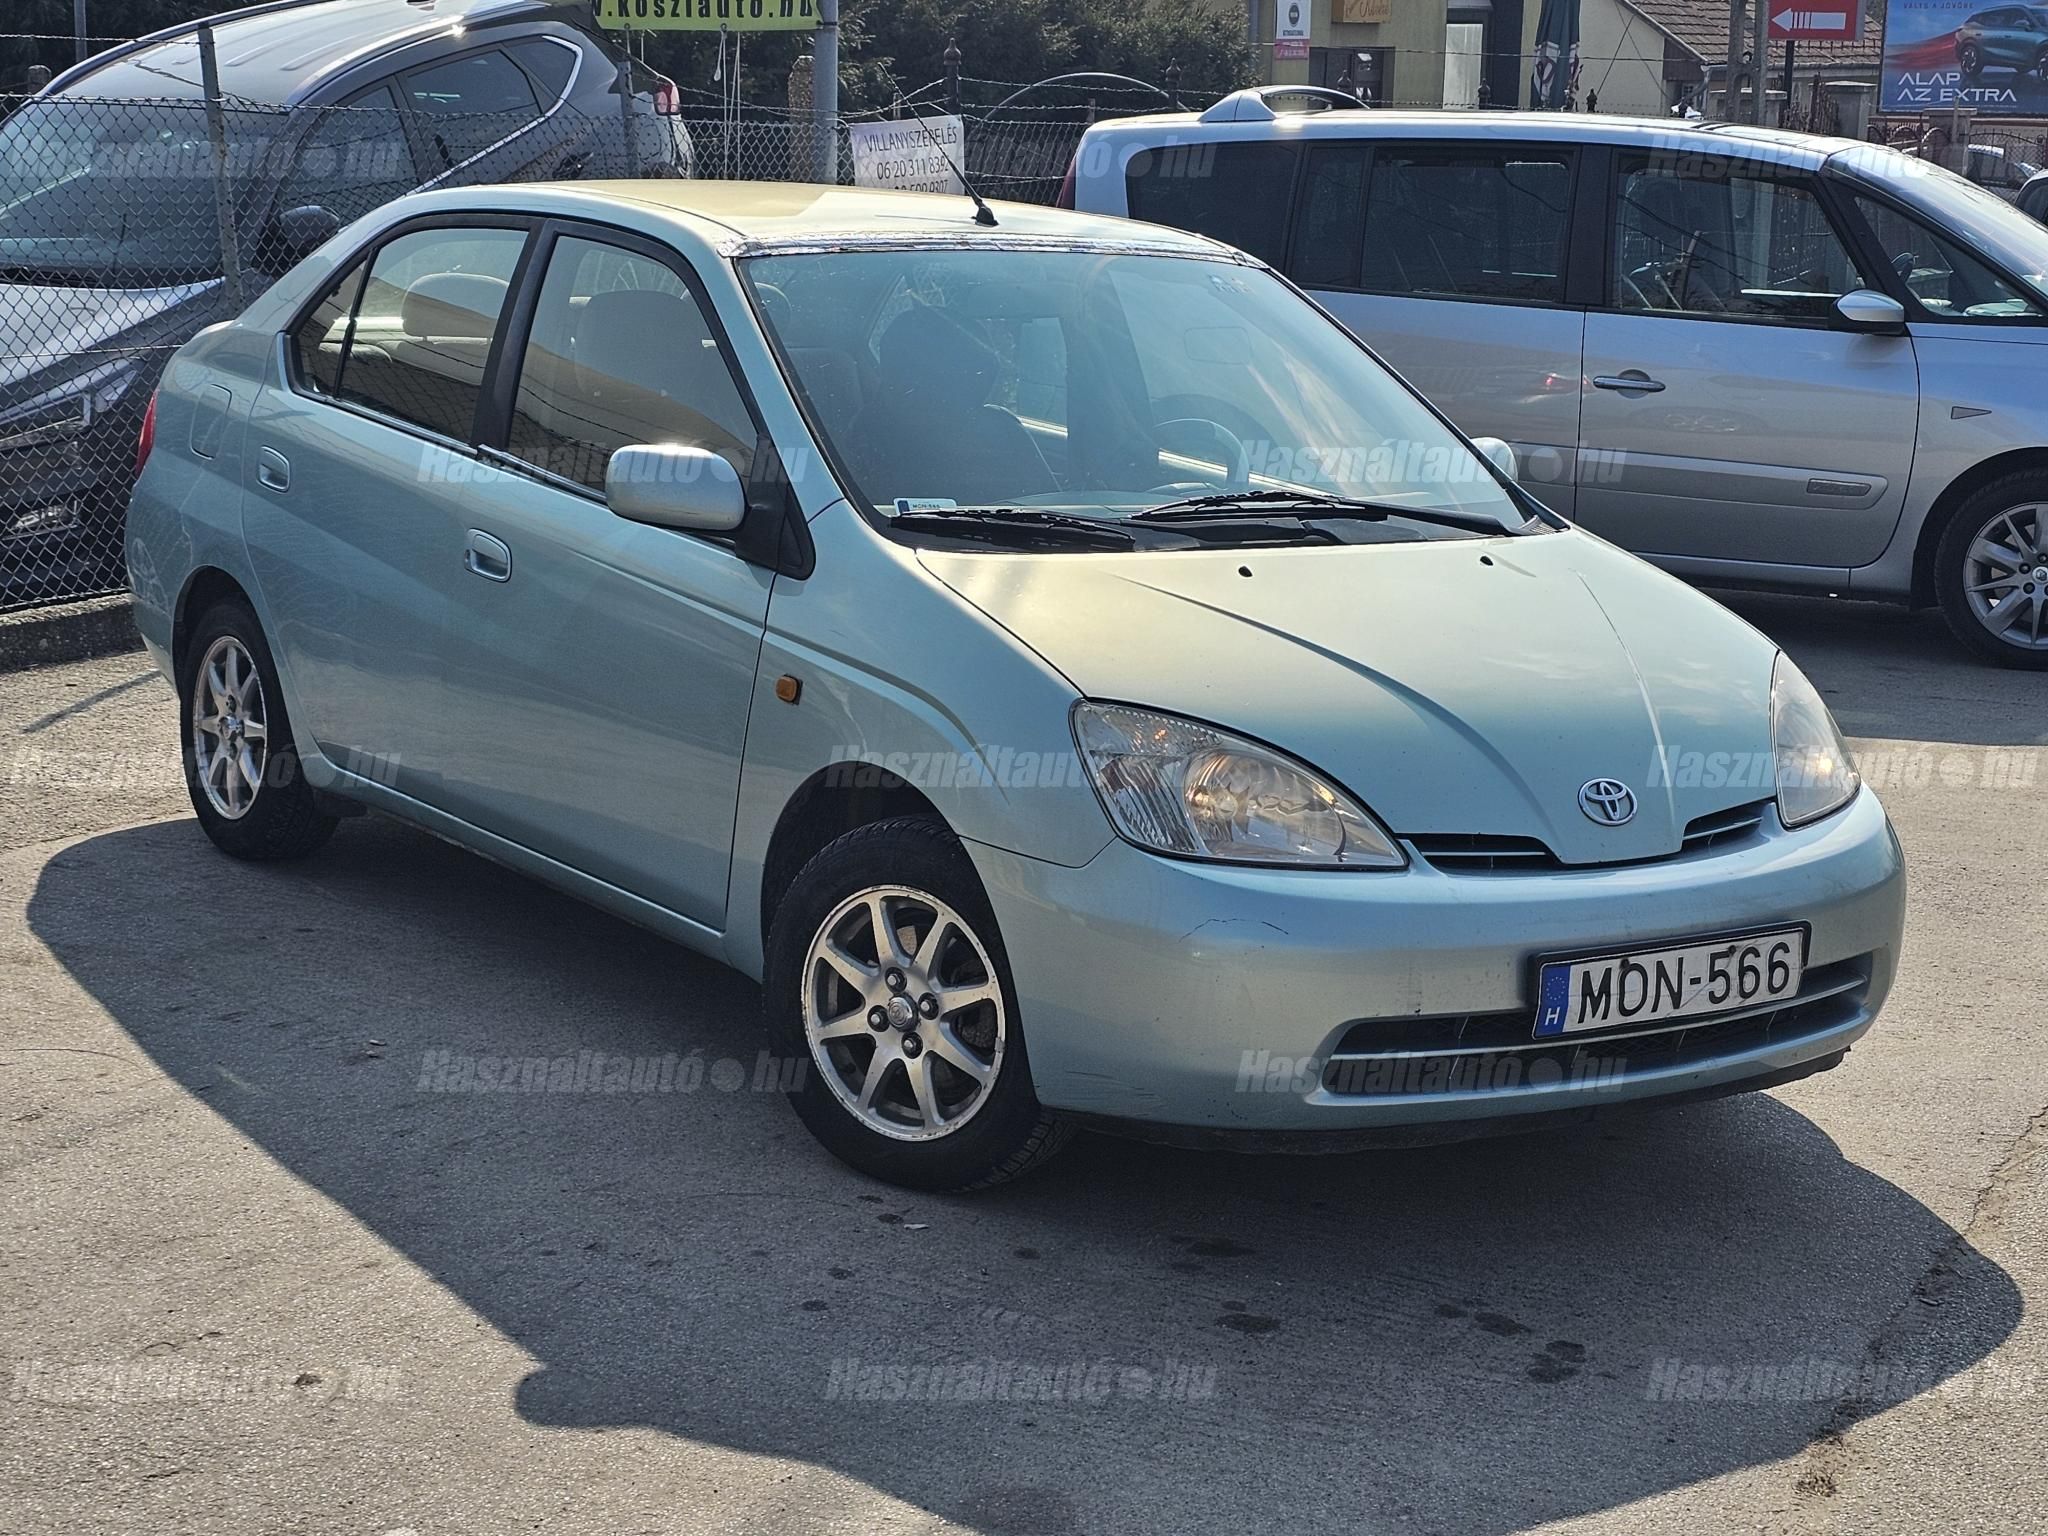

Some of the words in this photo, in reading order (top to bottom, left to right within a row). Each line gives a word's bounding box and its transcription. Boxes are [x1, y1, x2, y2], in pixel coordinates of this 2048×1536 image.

[1898, 72, 1961, 86] ALAP
[1897, 88, 1932, 102] AZ
[1939, 88, 2017, 102] EXTRA
[876, 162, 891, 180] 06
[894, 160, 907, 178] 20
[909, 158, 926, 176] 311
[1544, 1007, 1559, 1026] H
[1576, 941, 1790, 1025] MON-566
